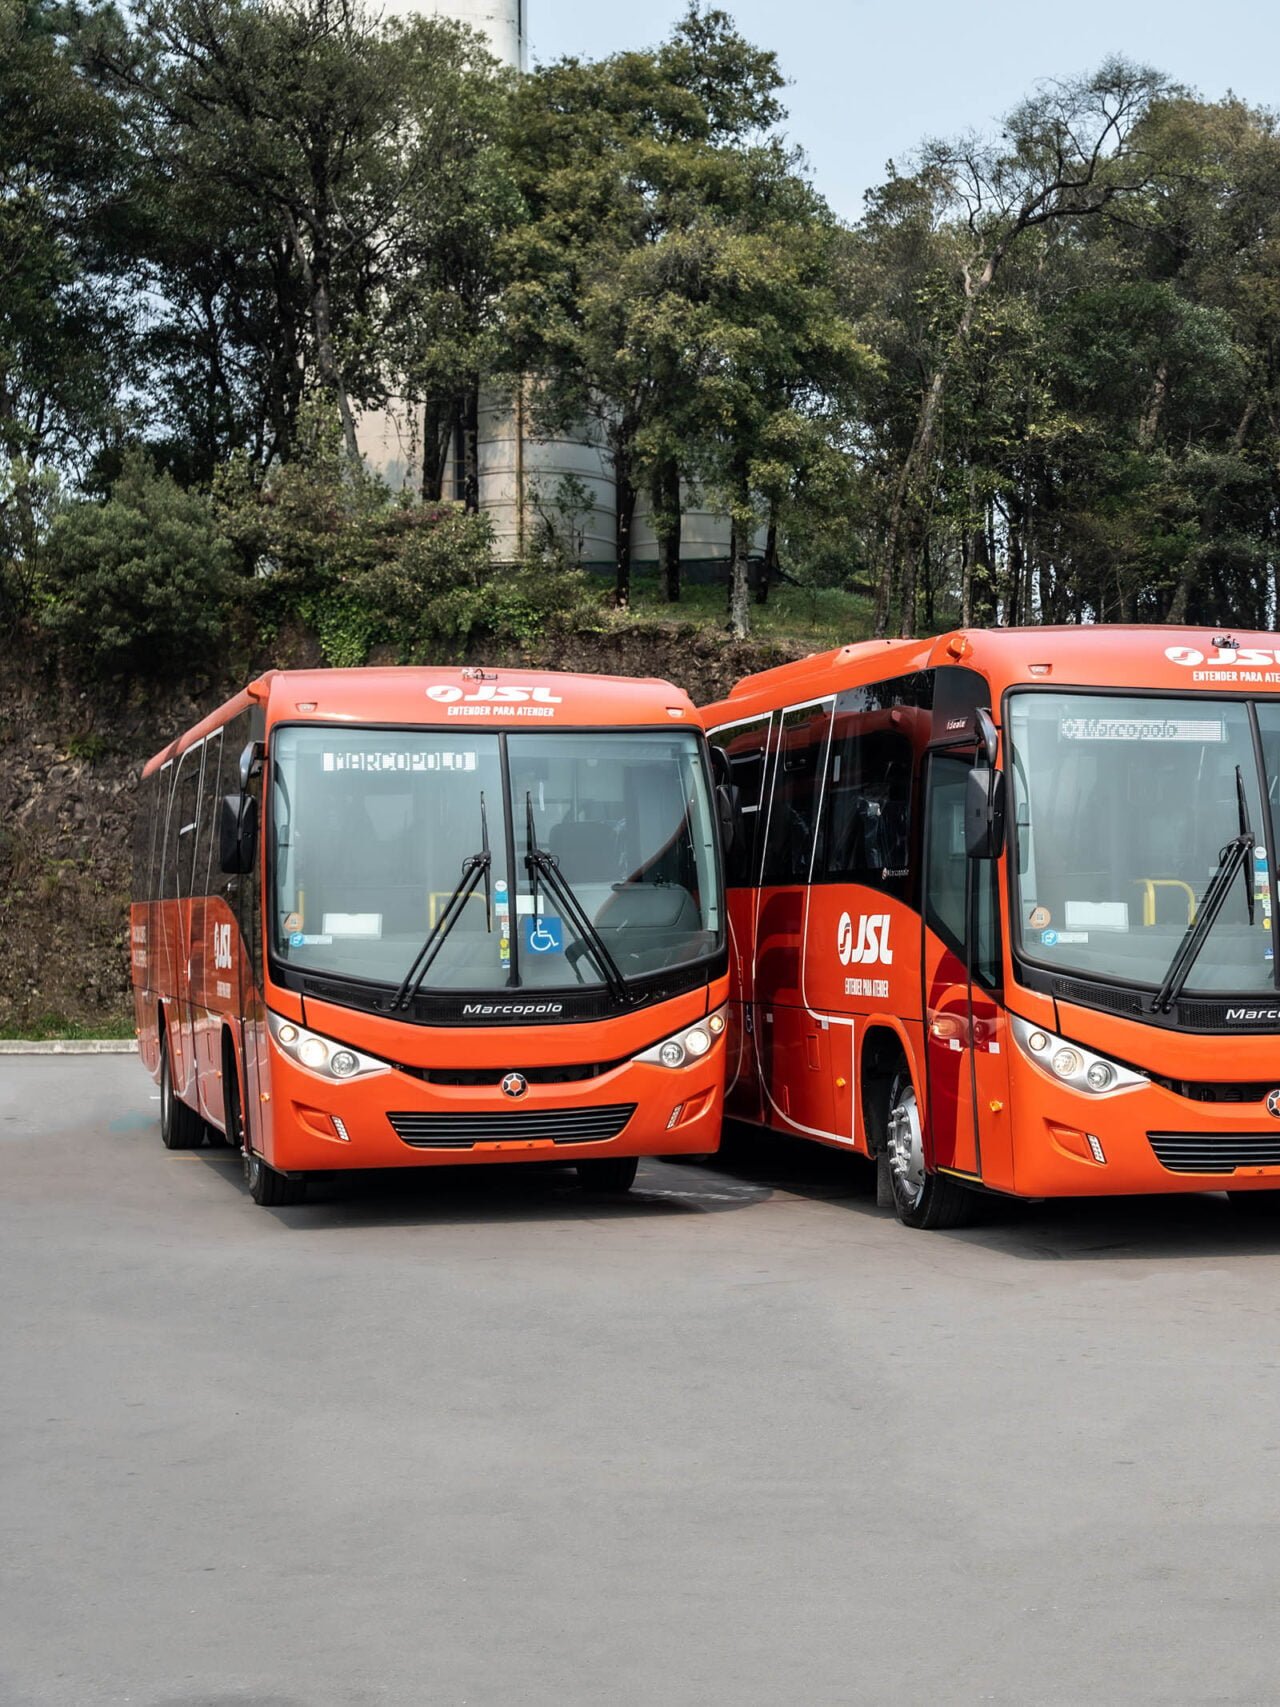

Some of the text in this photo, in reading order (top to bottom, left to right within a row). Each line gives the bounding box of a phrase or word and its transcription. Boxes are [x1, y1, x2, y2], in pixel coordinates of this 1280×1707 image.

[1193, 671, 1238, 682] ENTENDER
[1239, 671, 1263, 683] PARA
[464, 685, 563, 703] JSL
[447, 706, 555, 717] ENTENDER PARA ATENDER
[334, 752, 466, 771] MARCOPOLO
[851, 913, 893, 965] JSL
[463, 1003, 563, 1015] Marcopolo
